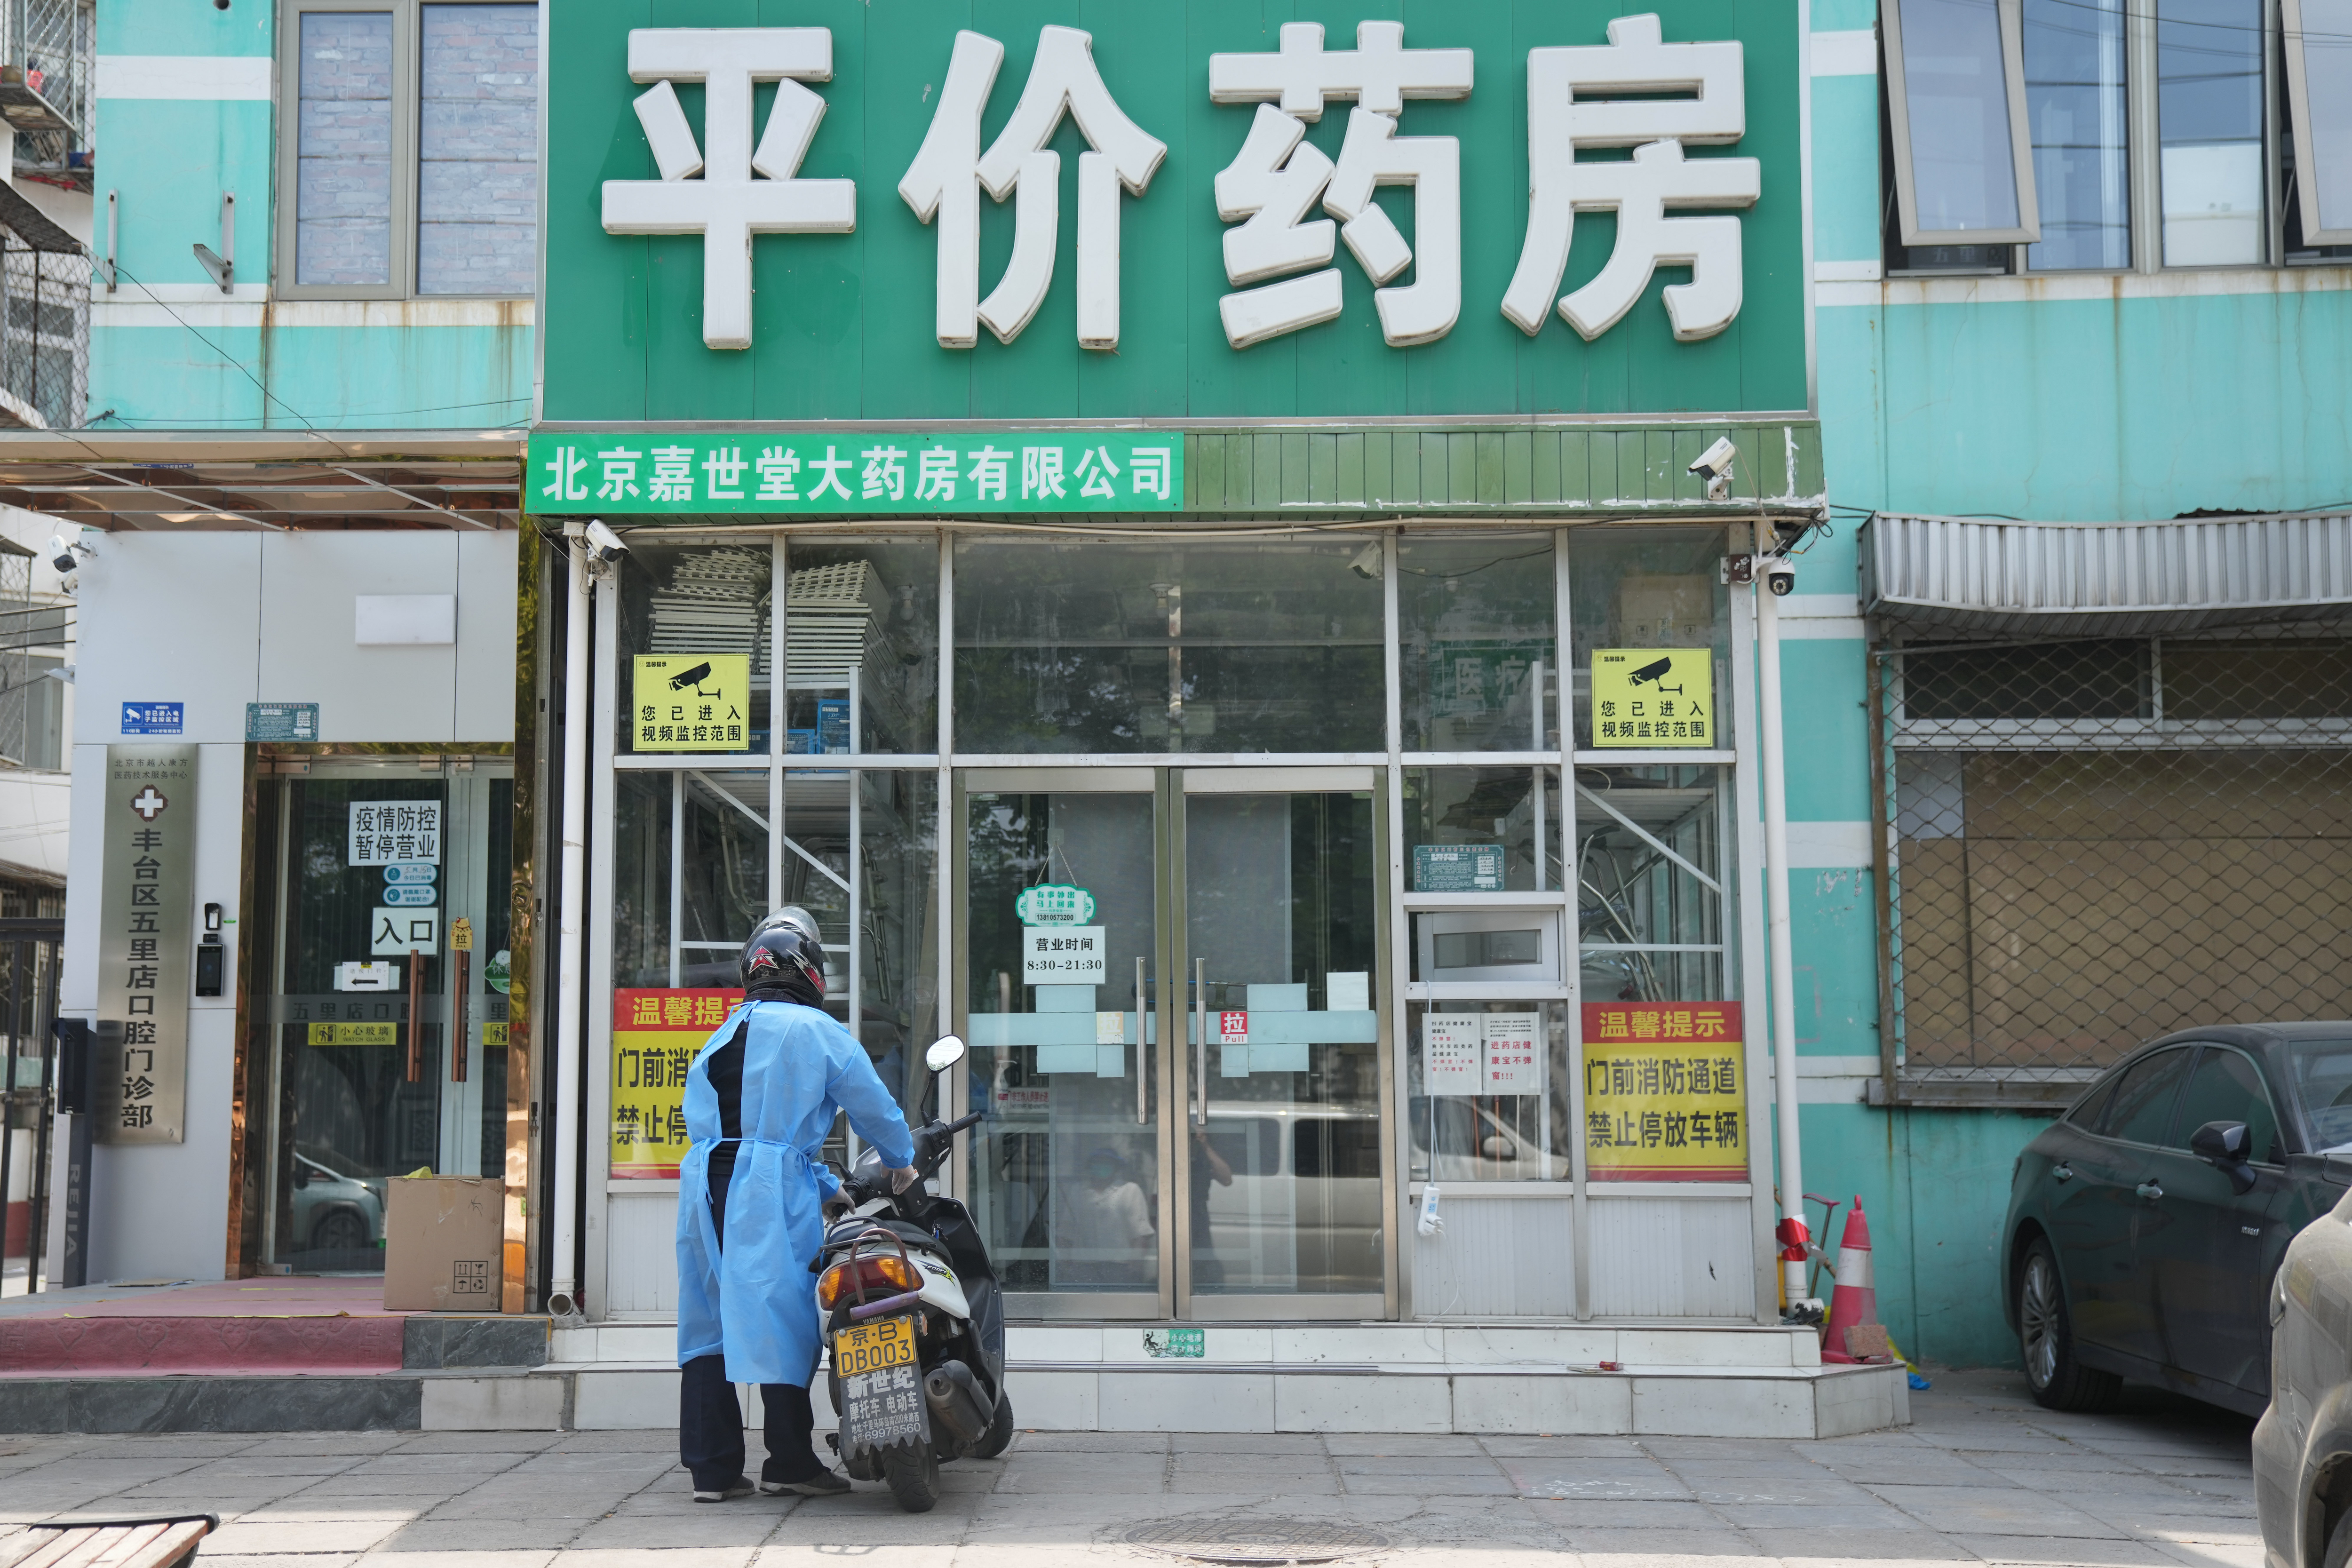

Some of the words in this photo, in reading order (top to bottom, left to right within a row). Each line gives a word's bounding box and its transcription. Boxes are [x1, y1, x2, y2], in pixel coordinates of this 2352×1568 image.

[601, 13, 1761, 351] 平价药房
[542, 445, 1172, 502] 北京嘉世堂大药房有限公司
[641, 705, 741, 721] 您已进入
[1601, 700, 1704, 716] 您已进入
[642, 725, 741, 741] 视频监控范围
[1602, 721, 1704, 738] 视频监控范围
[114, 758, 188, 767] 北京市越人康方
[114, 771, 188, 780] 医药技术服务中心
[356, 806, 436, 832] 疫情防控
[356, 834, 435, 860] 暂停营业
[374, 916, 433, 945] 入口
[455, 934, 467, 944] 拉
[1036, 938, 1093, 951] 营业时间
[1027, 960, 1102, 970] 8:30-21:30
[120, 828, 163, 1129] 丰台区五里店口腔门诊部
[341, 1026, 389, 1035] 小心玻璃
[1100, 1013, 1120, 1033] 拉
[1224, 1013, 1245, 1034] 拉
[1599, 1011, 1725, 1038] 温馨提示
[1491, 1041, 1532, 1050] 进药店健
[618, 1047, 700, 1088] 门前消
[1491, 1056, 1532, 1065] 康宝不弹
[1587, 1058, 1736, 1095] 门前消防通道
[1588, 1111, 1738, 1148] 禁止停放车辆
[66, 1164, 80, 1258] REJIA
[863, 1315, 885, 1325] YAMAHA
[1171, 1333, 1202, 1342] 小心地滑
[841, 1339, 910, 1374] DB003
[847, 1366, 915, 1400] 新世纪
[849, 1397, 881, 1422] 摩托车
[886, 1391, 918, 1414] 电动车
